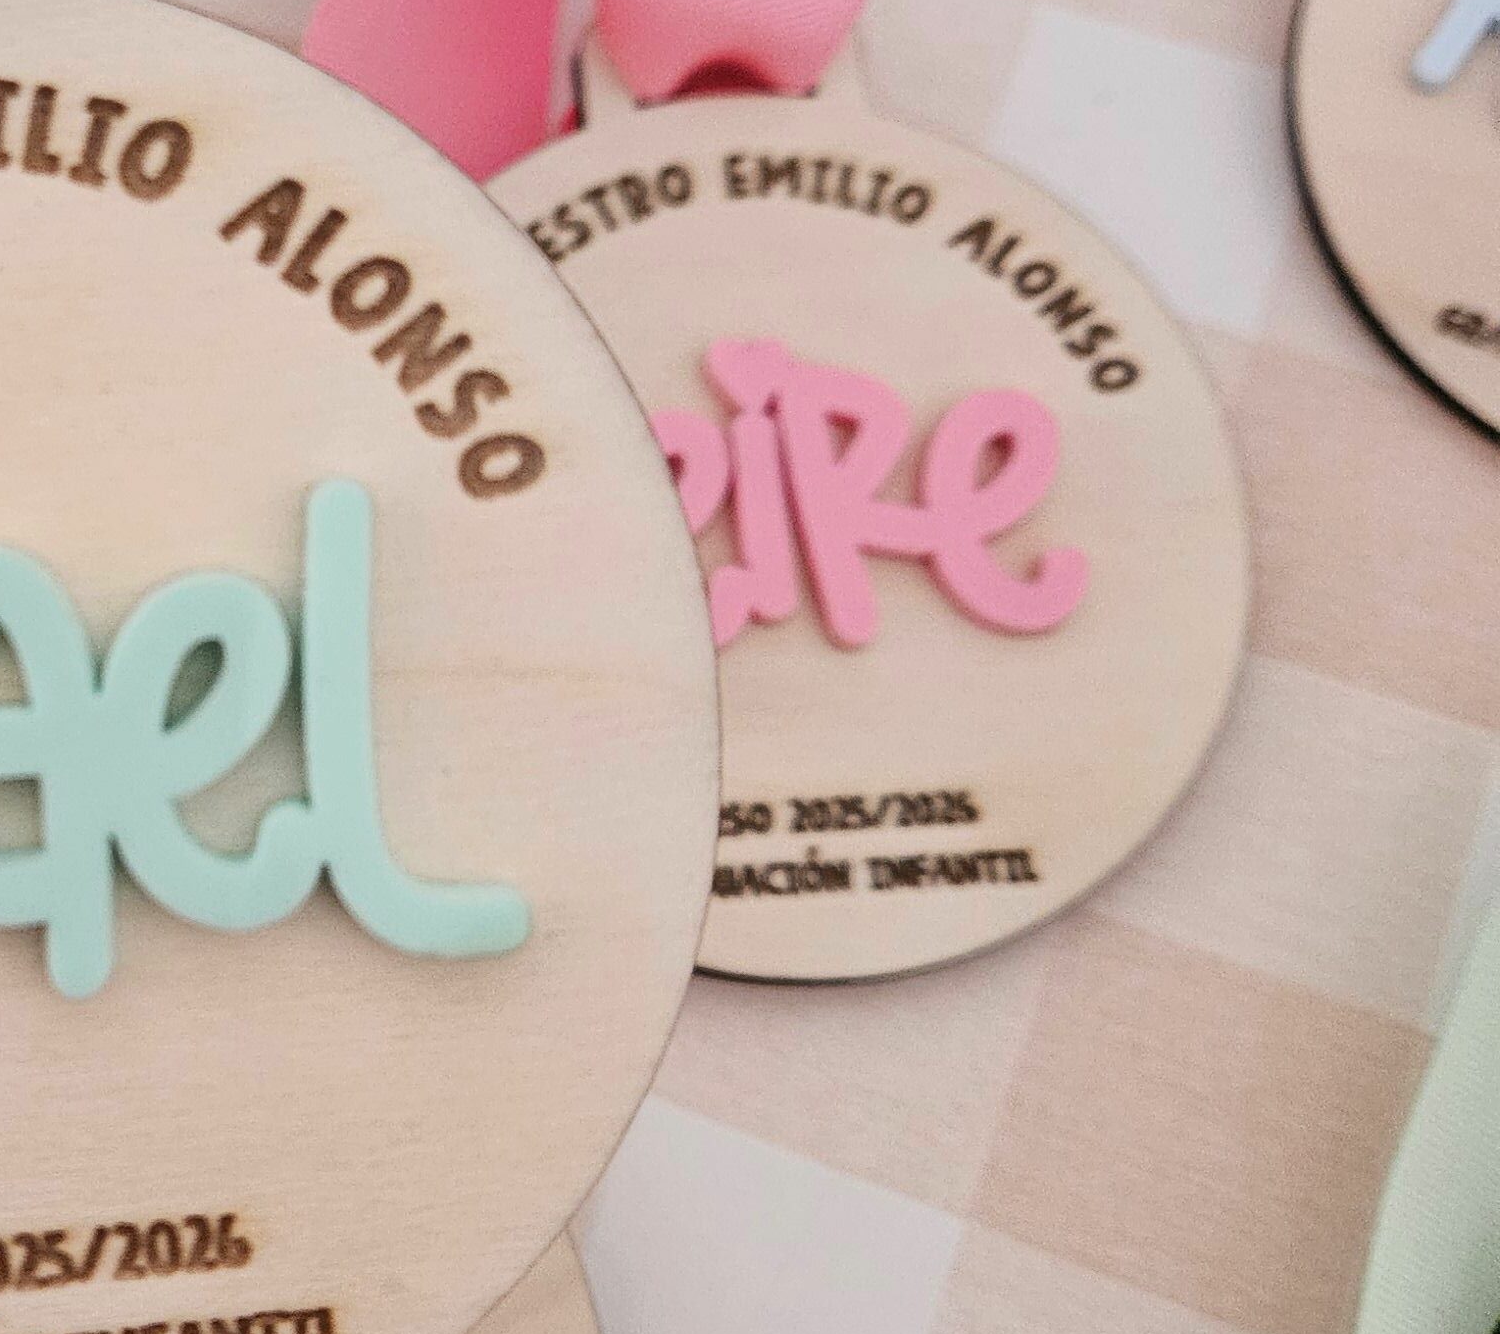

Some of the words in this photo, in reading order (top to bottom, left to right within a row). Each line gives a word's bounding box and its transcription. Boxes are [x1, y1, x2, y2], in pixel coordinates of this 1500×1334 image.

[218, 178, 546, 501] ALONSO
[724, 153, 932, 225] EMILIO
[949, 217, 1141, 394] ALONSO
[865, 847, 1039, 891] INFANTIL
